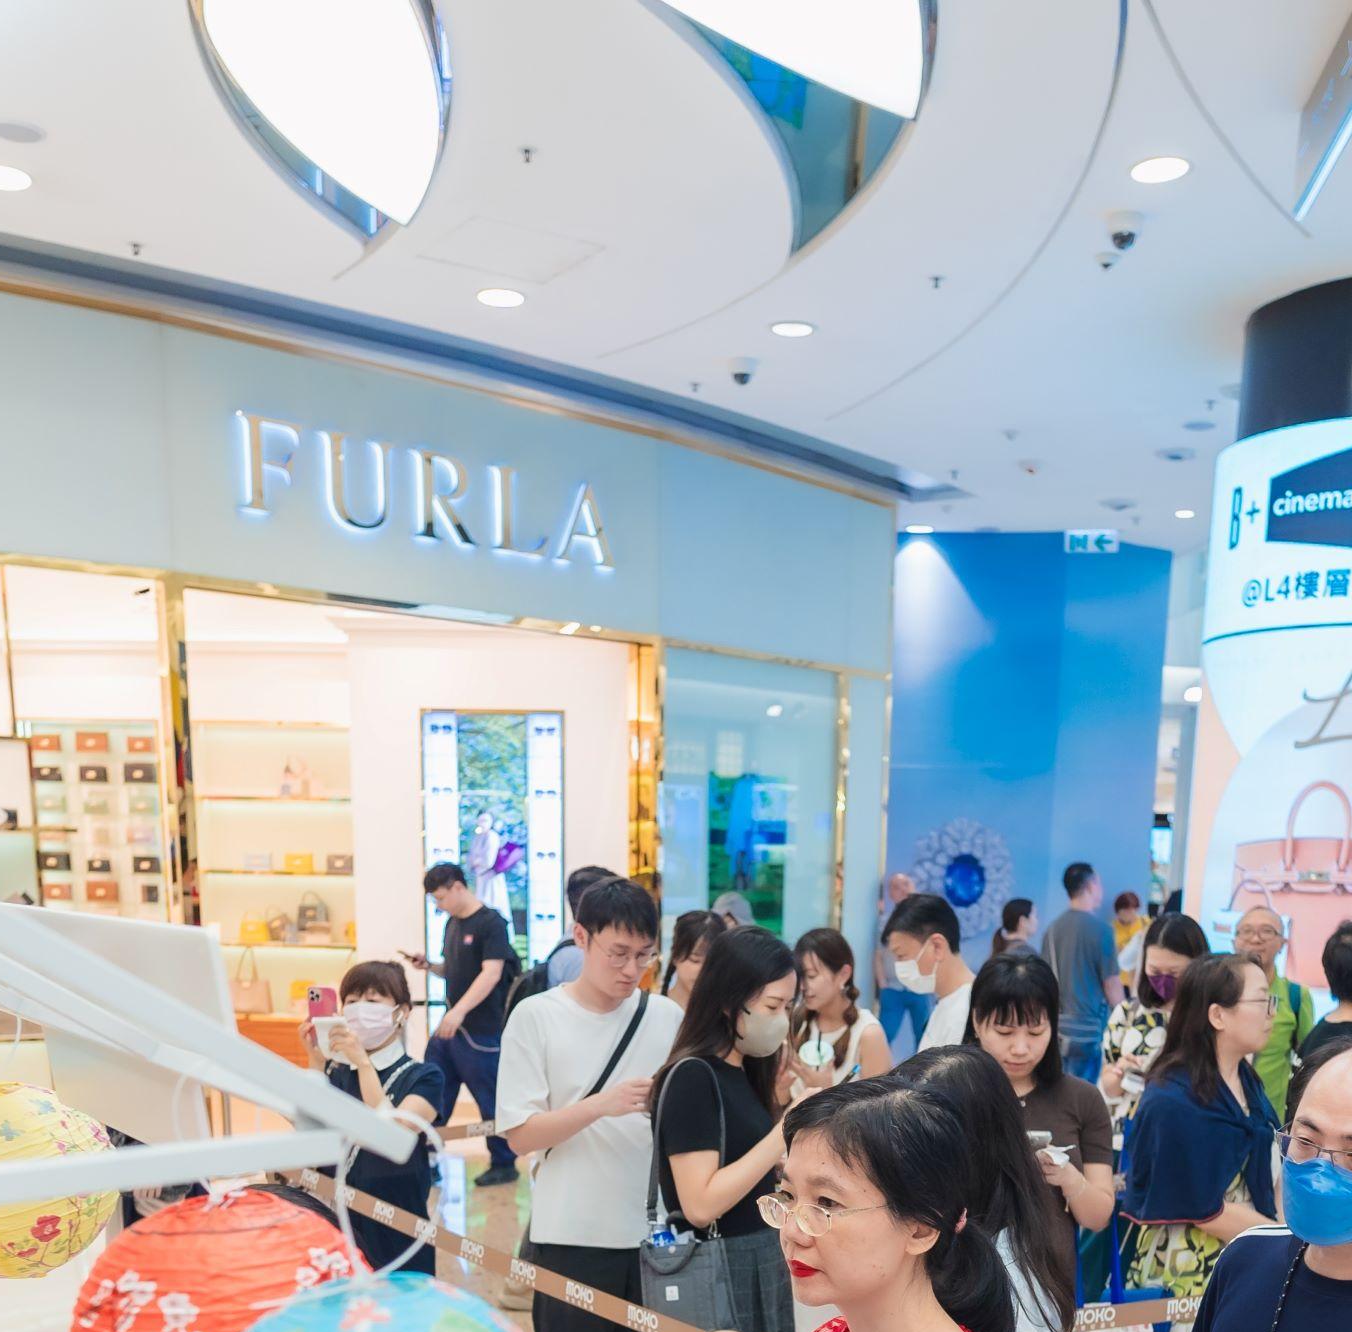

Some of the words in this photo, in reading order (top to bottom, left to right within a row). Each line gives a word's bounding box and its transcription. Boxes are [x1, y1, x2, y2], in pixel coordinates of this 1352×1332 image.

[236, 410, 616, 573] FURLA
[1242, 567, 1352, 608] @L4樓層
[460, 1239, 484, 1259] MOKO
[510, 1258, 536, 1280] MOKO
[565, 1281, 594, 1304] MOKO
[627, 1303, 659, 1330] MOKO
